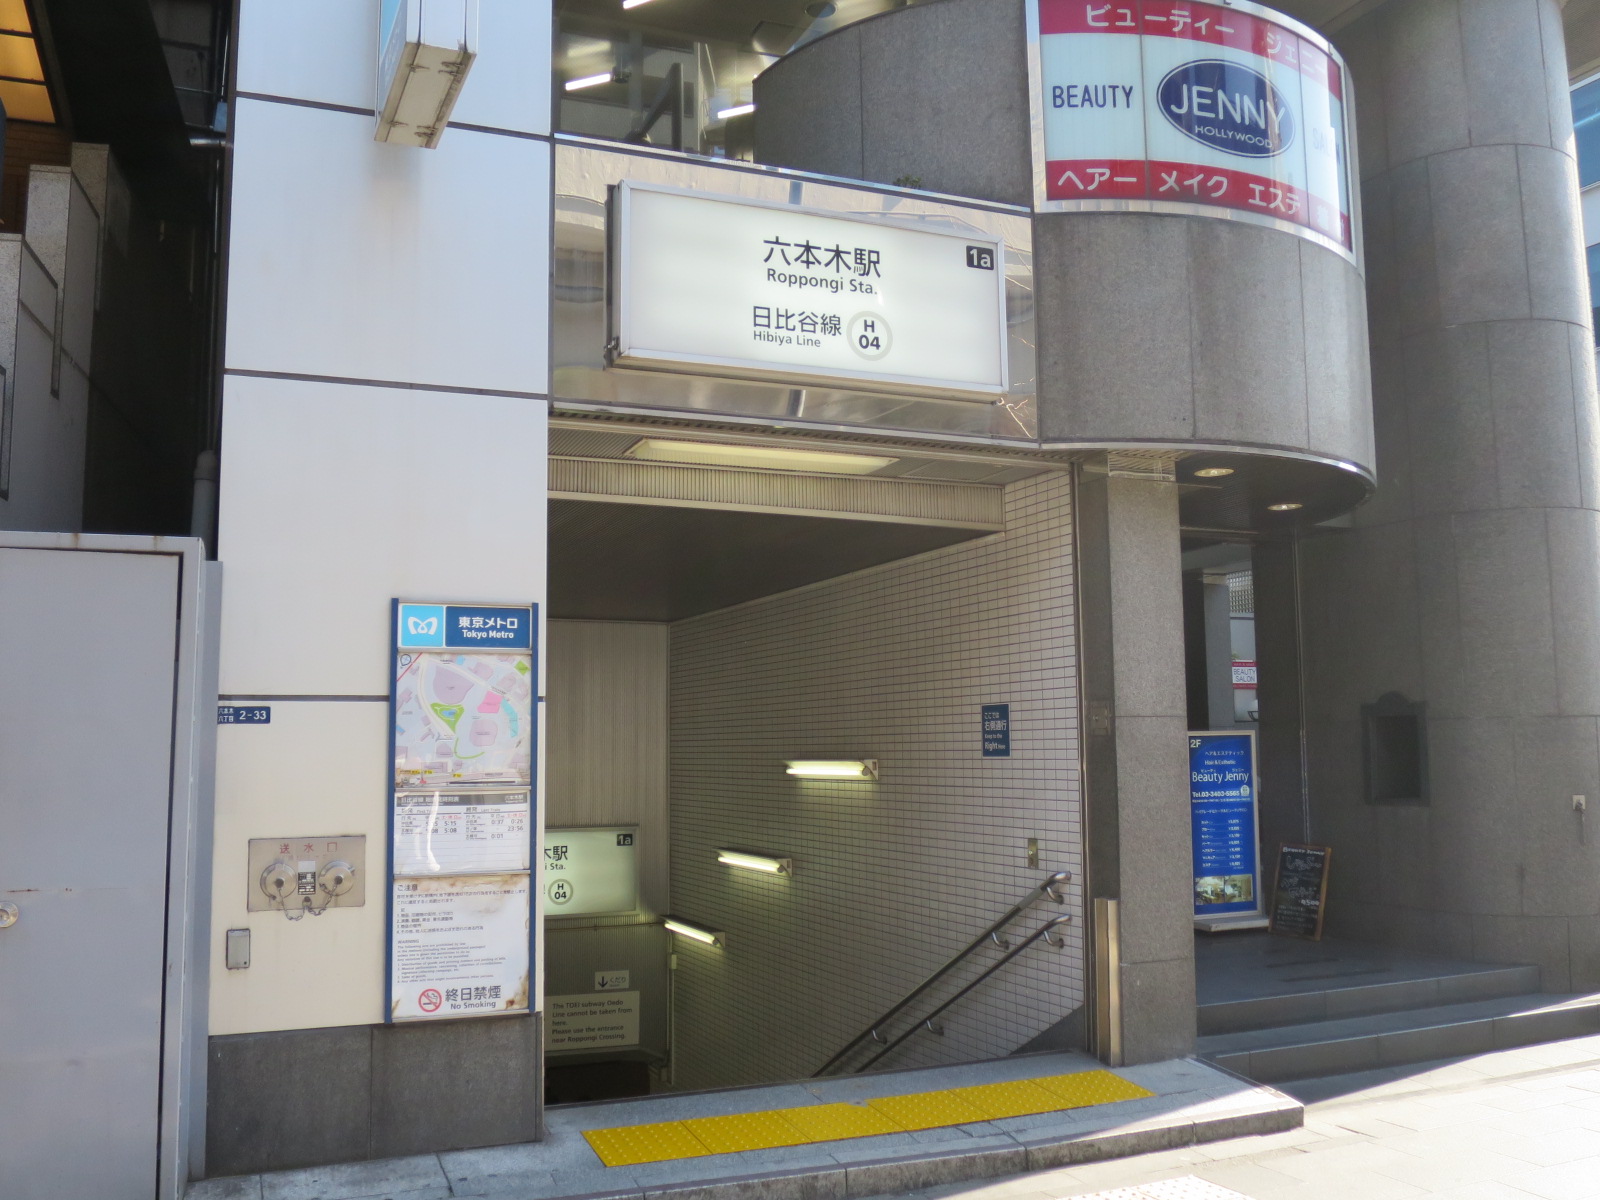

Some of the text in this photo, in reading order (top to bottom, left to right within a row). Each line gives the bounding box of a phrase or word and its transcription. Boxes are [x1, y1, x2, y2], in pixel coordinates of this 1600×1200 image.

[1086, 4, 1234, 35] ビューティー
[1052, 85, 1133, 108] BEAUTY
[1170, 83, 1286, 133] JENNY
[1195, 125, 1273, 149] HOLLYWOOD
[1058, 167, 1137, 190] ヘアー
[1159, 170, 1228, 197] メイク
[1248, 183, 1300, 214] エステ
[763, 235, 881, 278] 六本木駅
[969, 248, 991, 268] 1a
[767, 268, 878, 295] Roppongi Sta.
[753, 306, 842, 336] 日比谷線
[863, 319, 875, 333] H
[753, 331, 821, 348] Hibiya Line
[858, 335, 881, 350] 04
[458, 616, 518, 629] 東京メトロ
[462, 630, 514, 640] Tokyo Metro
[239, 710, 267, 720] 2-33
[984, 720, 1007, 730] 右側通行
[984, 742, 998, 751] Right
[1190, 740, 1201, 748] 2F
[1192, 771, 1249, 784] Beauty Jenny
[618, 835, 632, 845] 1a
[550, 862, 566, 870] Sta.
[554, 892, 567, 900] 04
[445, 986, 502, 1002] 終日禁煙
[464, 1000, 496, 1010] Smoking
